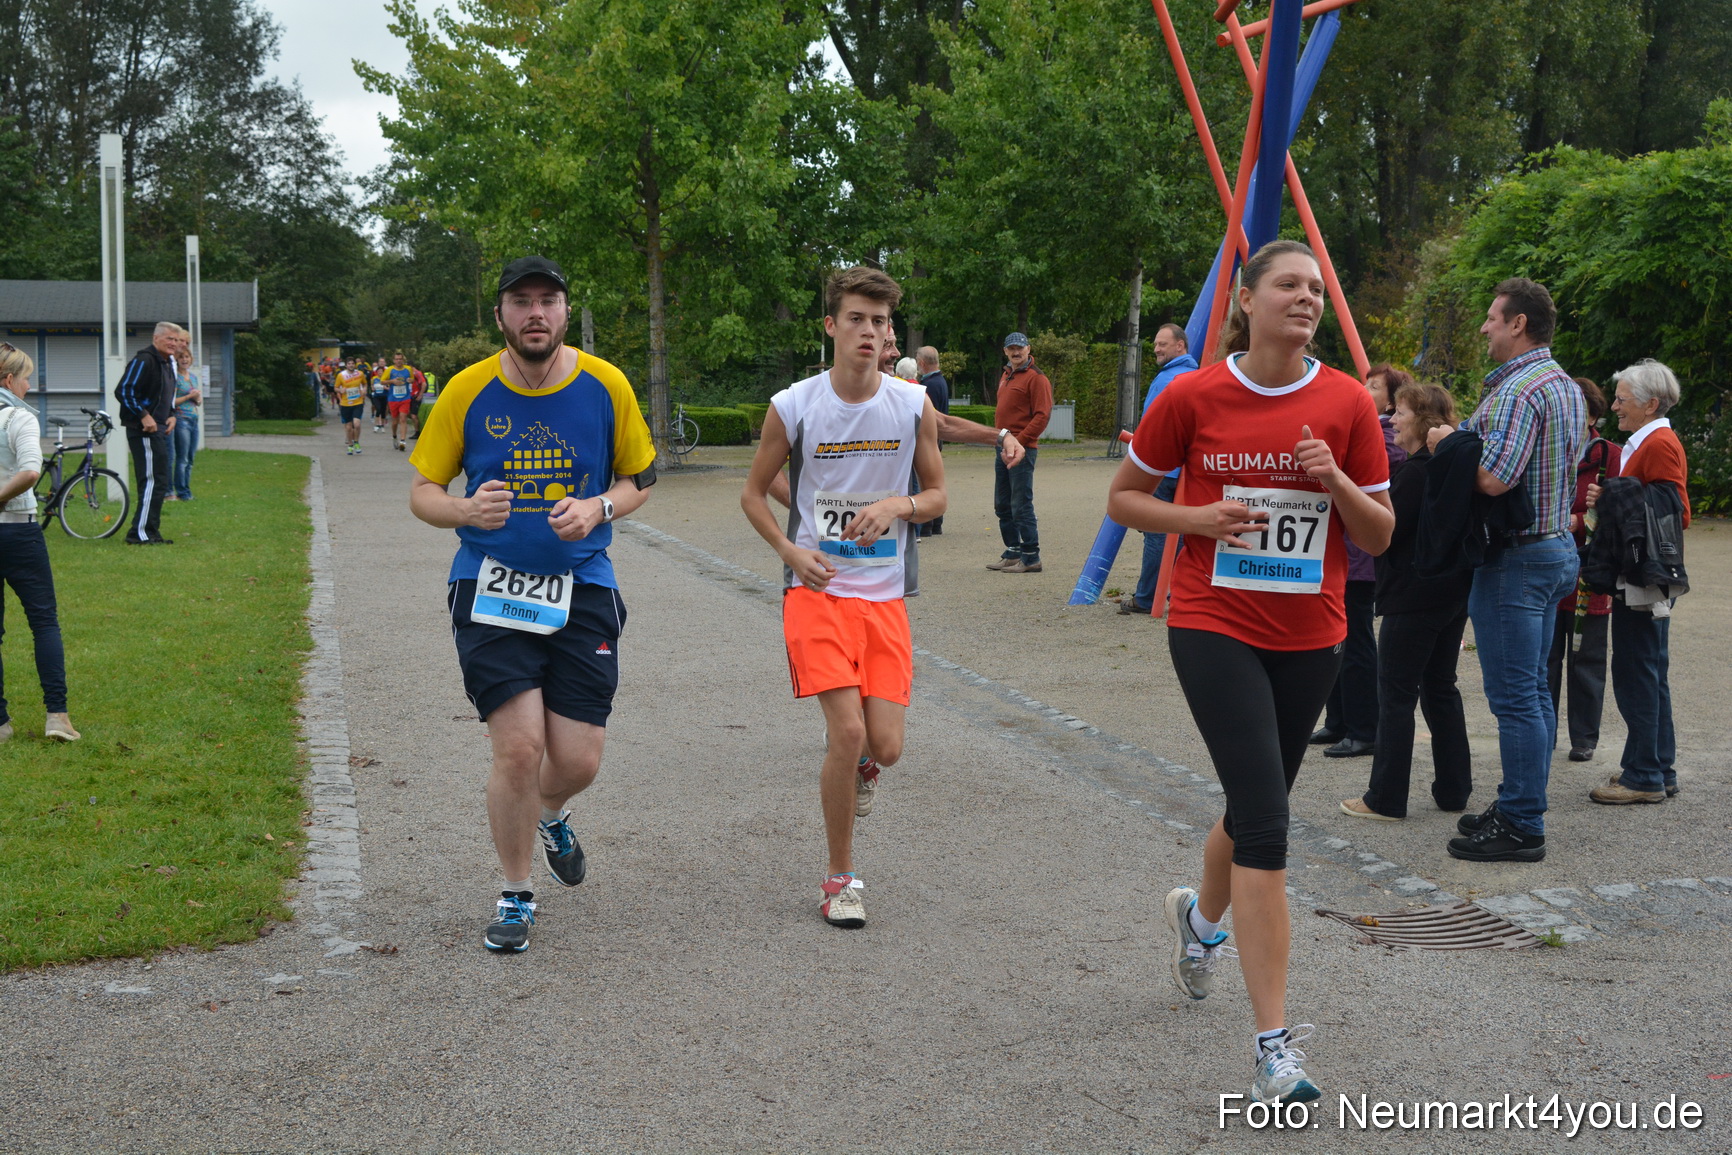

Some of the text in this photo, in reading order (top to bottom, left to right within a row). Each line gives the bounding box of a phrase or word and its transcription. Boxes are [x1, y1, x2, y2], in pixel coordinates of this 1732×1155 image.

[1203, 453, 1306, 471] NEUMAR
[1298, 476, 1320, 484] STADT
[816, 499, 883, 507] PARTL Neum
[1261, 498, 1312, 511] Neumarkt
[840, 545, 876, 556] Markus
[1238, 559, 1302, 579] Christina
[486, 566, 564, 604] 2620
[501, 603, 540, 623] Ronny
